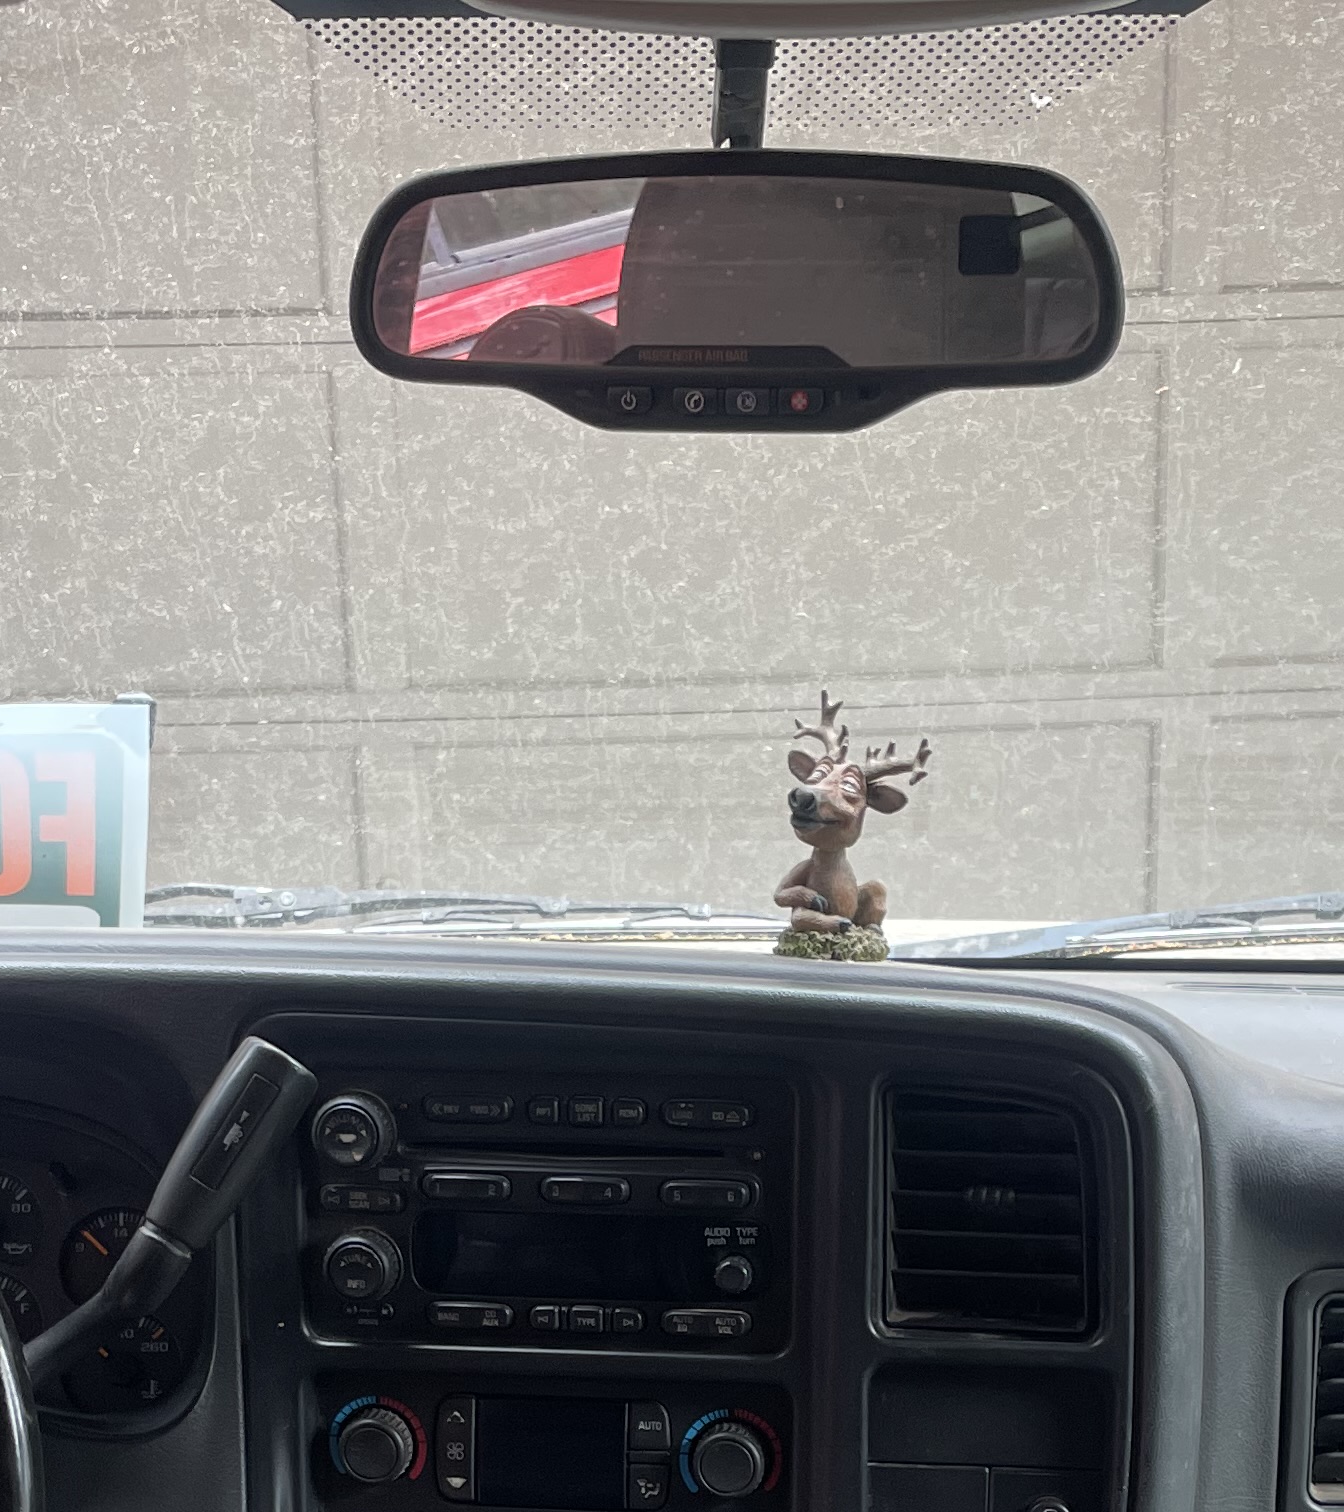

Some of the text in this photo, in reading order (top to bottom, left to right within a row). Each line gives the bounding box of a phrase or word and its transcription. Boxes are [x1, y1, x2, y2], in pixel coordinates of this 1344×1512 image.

[576, 1112, 598, 1122] LIST
[551, 1185, 560, 1197] 3
[603, 1187, 612, 1199] 4
[673, 1190, 682, 1202] 5
[727, 1191, 736, 1202] 6
[704, 1227, 759, 1237] AUDIO TYPE
[707, 1237, 727, 1247] push
[346, 1280, 367, 1290] INFO
[20, 1303, 30, 1315] F
[577, 1317, 596, 1327] TYPE
[715, 1317, 737, 1327] AUTO
[141, 1343, 169, 1353] 260
[638, 1420, 664, 1431] AUTO
